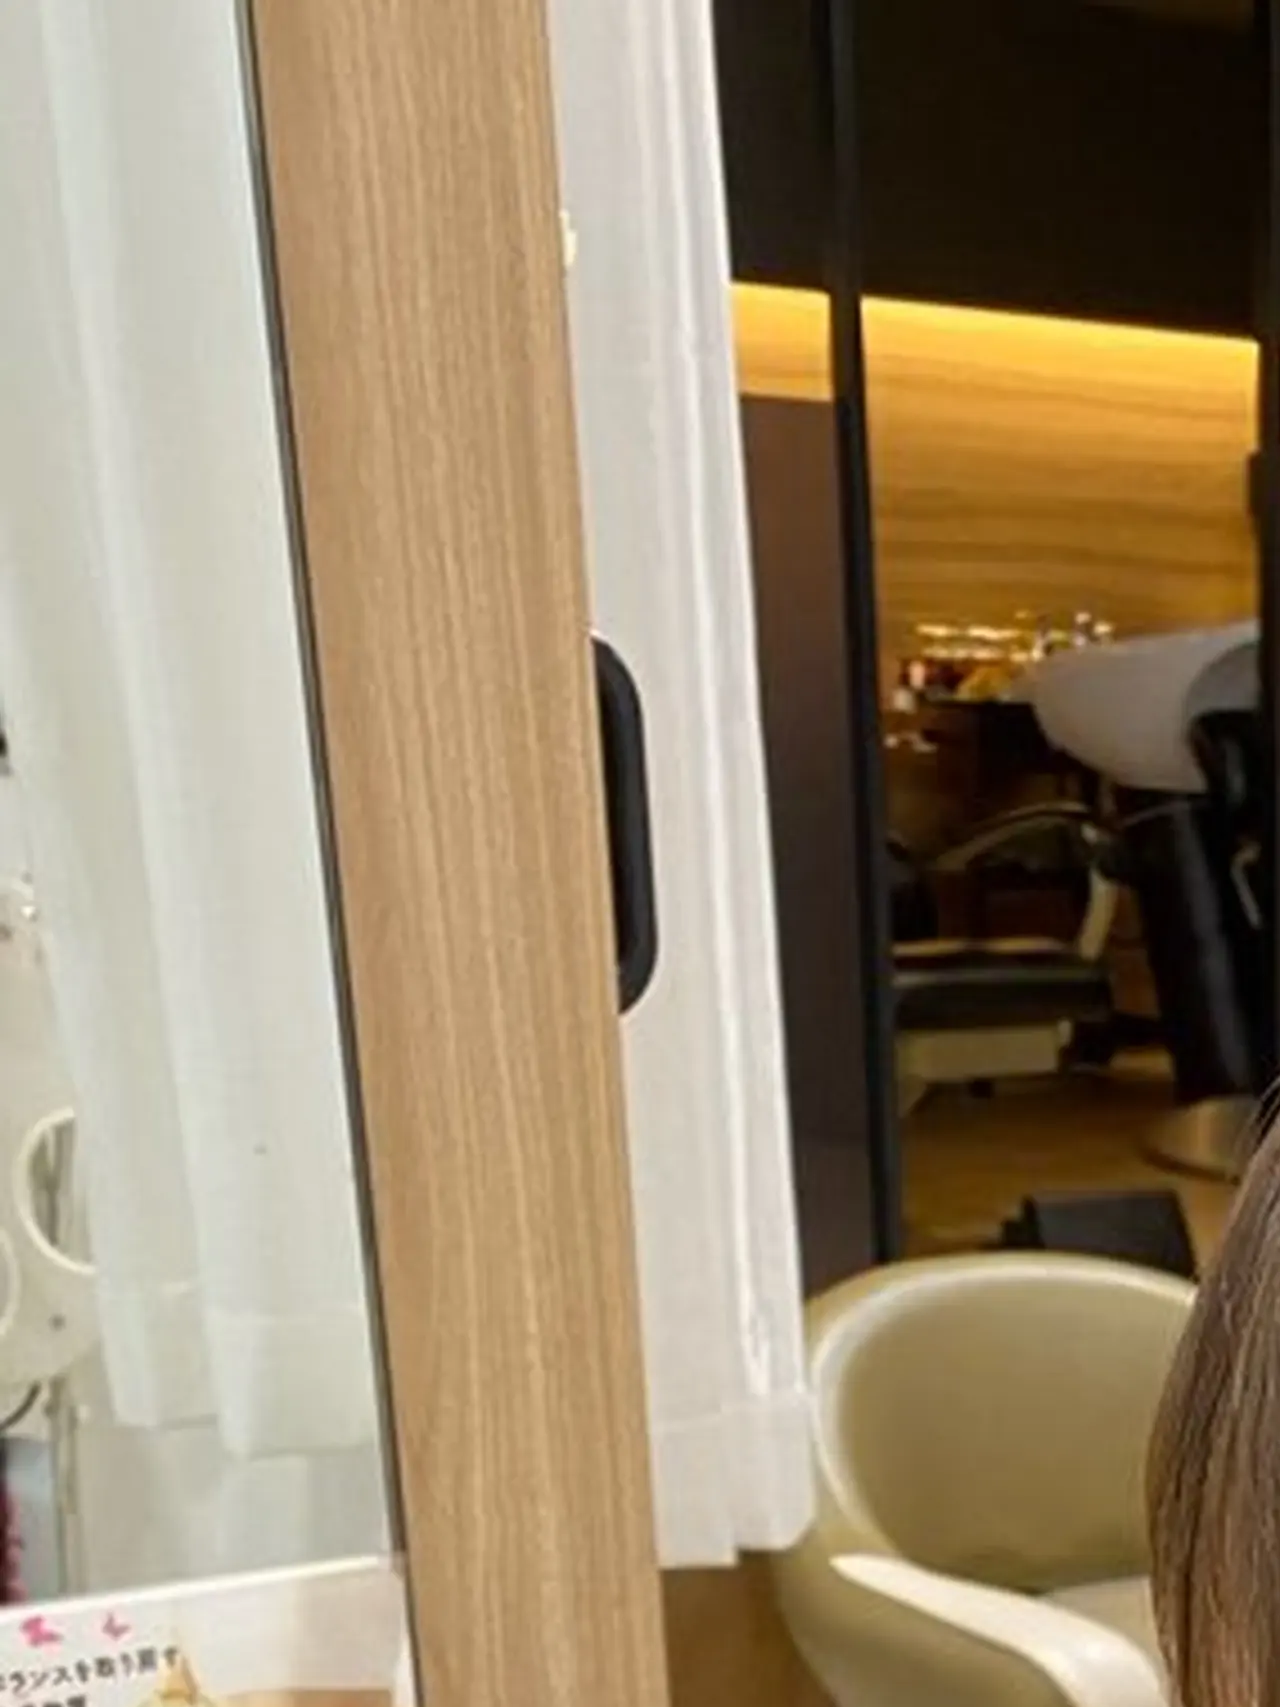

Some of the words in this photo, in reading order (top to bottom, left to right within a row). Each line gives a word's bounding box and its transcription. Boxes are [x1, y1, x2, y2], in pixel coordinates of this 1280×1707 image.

[0, 1647, 178, 1696] ランスを取り戻す
